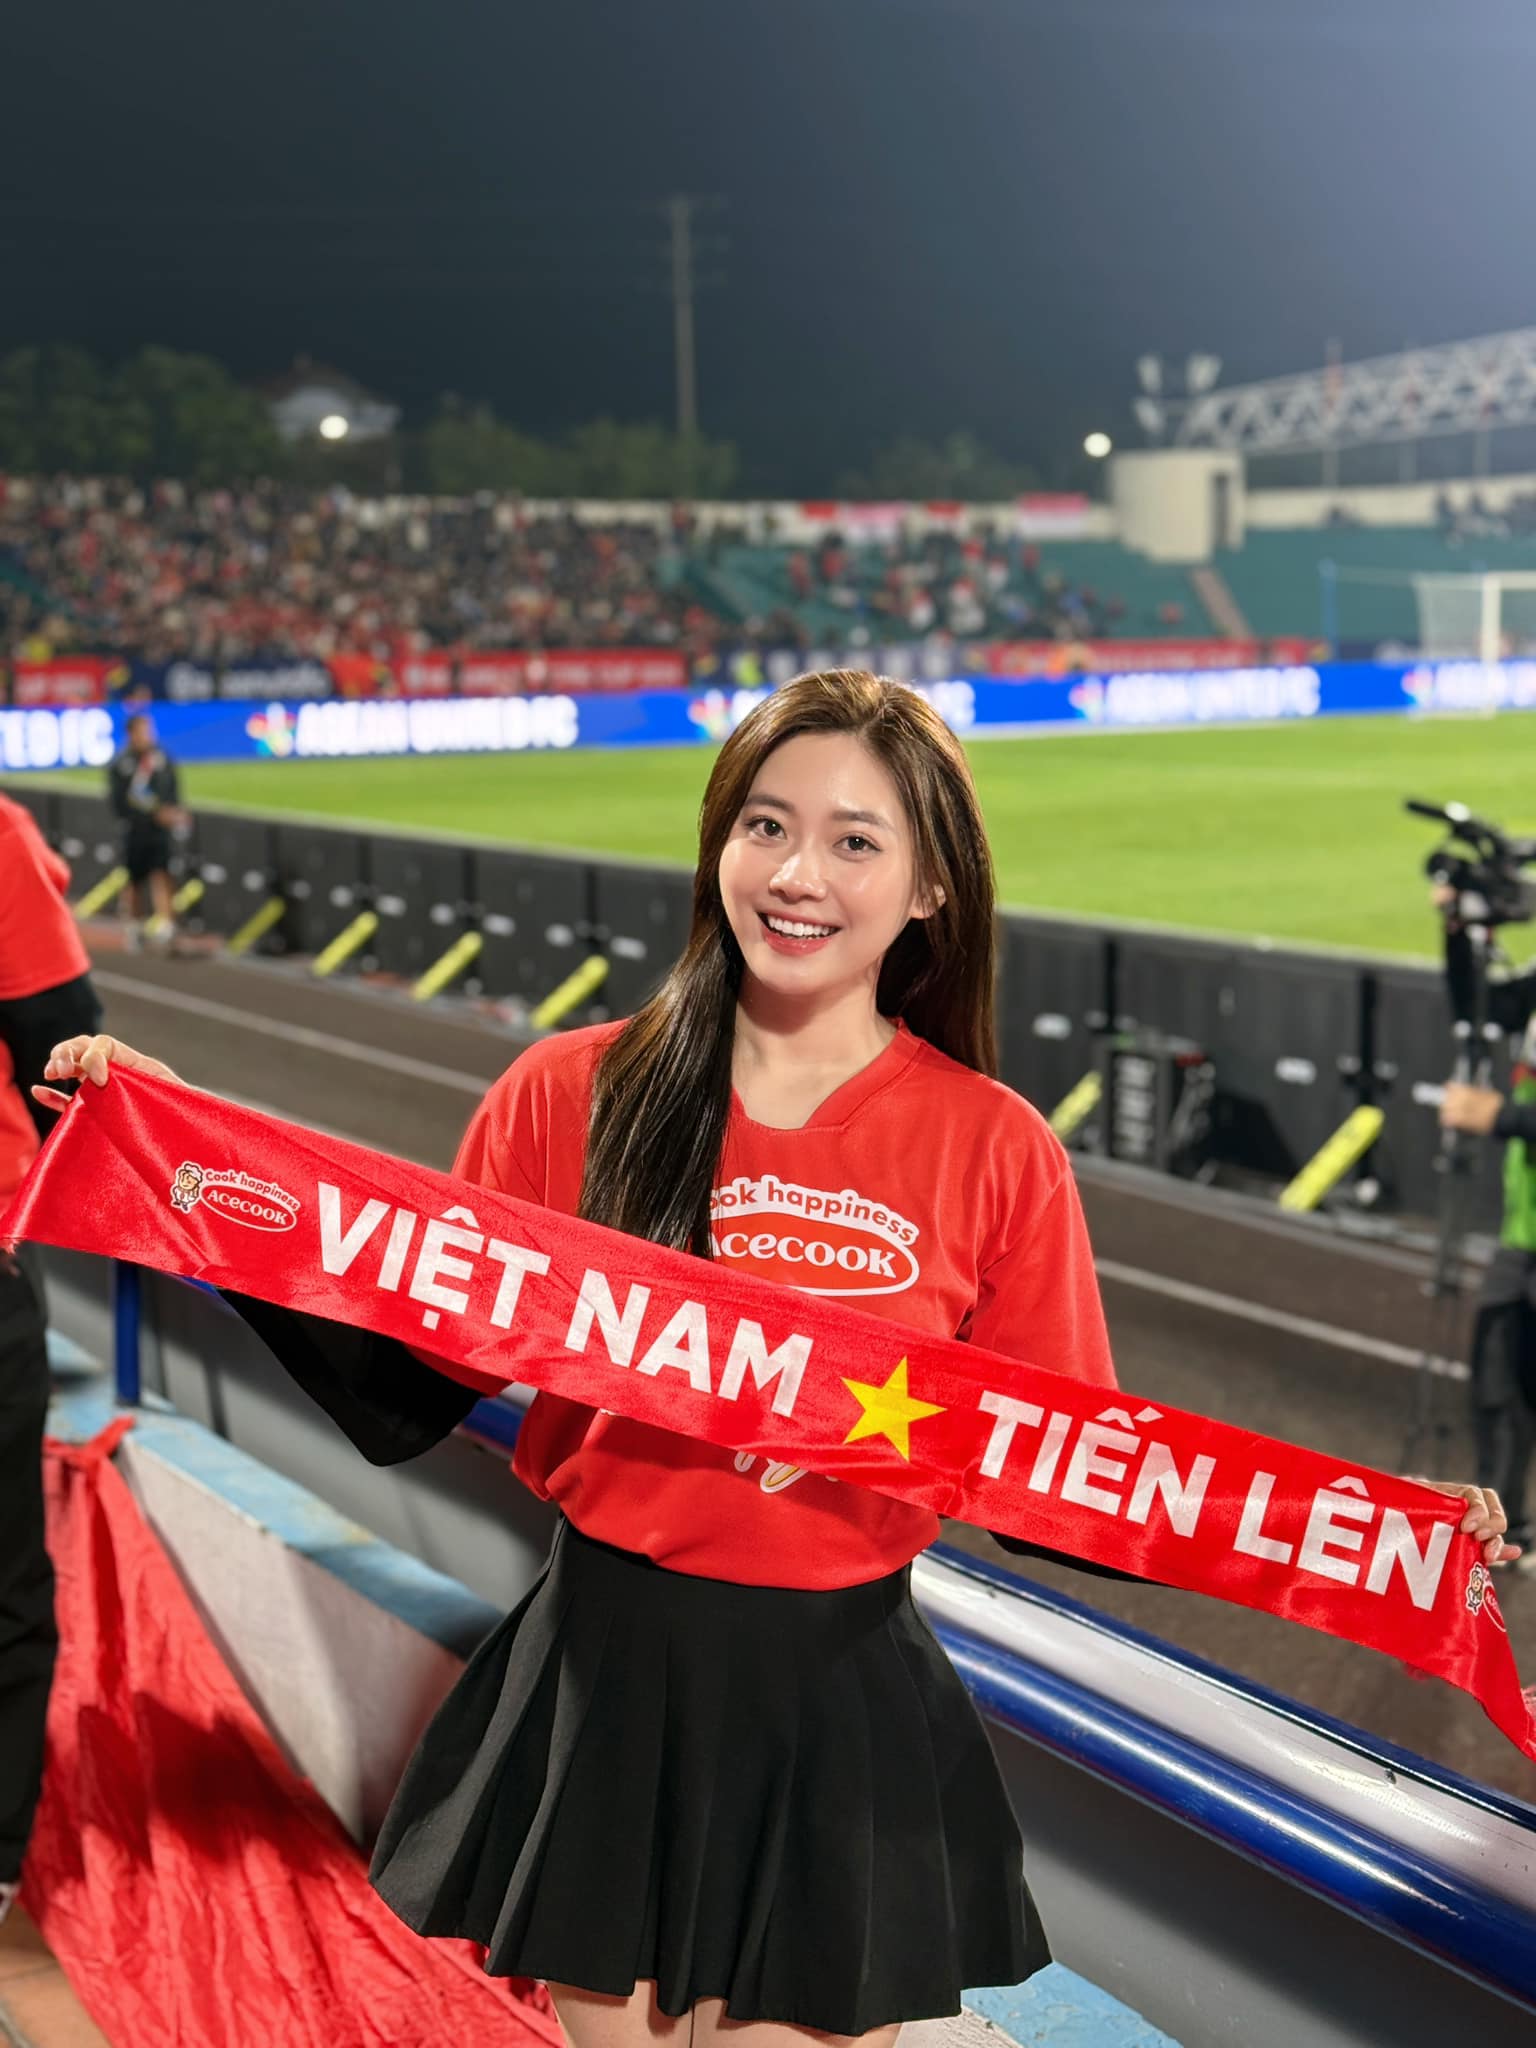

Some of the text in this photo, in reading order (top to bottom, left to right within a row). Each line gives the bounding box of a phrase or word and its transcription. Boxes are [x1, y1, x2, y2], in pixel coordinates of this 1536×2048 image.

[205, 1170, 299, 1211] Cook happiness
[768, 1181, 914, 1243] happiness
[317, 1181, 1455, 1611] VIỆT NAM TIẾN LÊN
